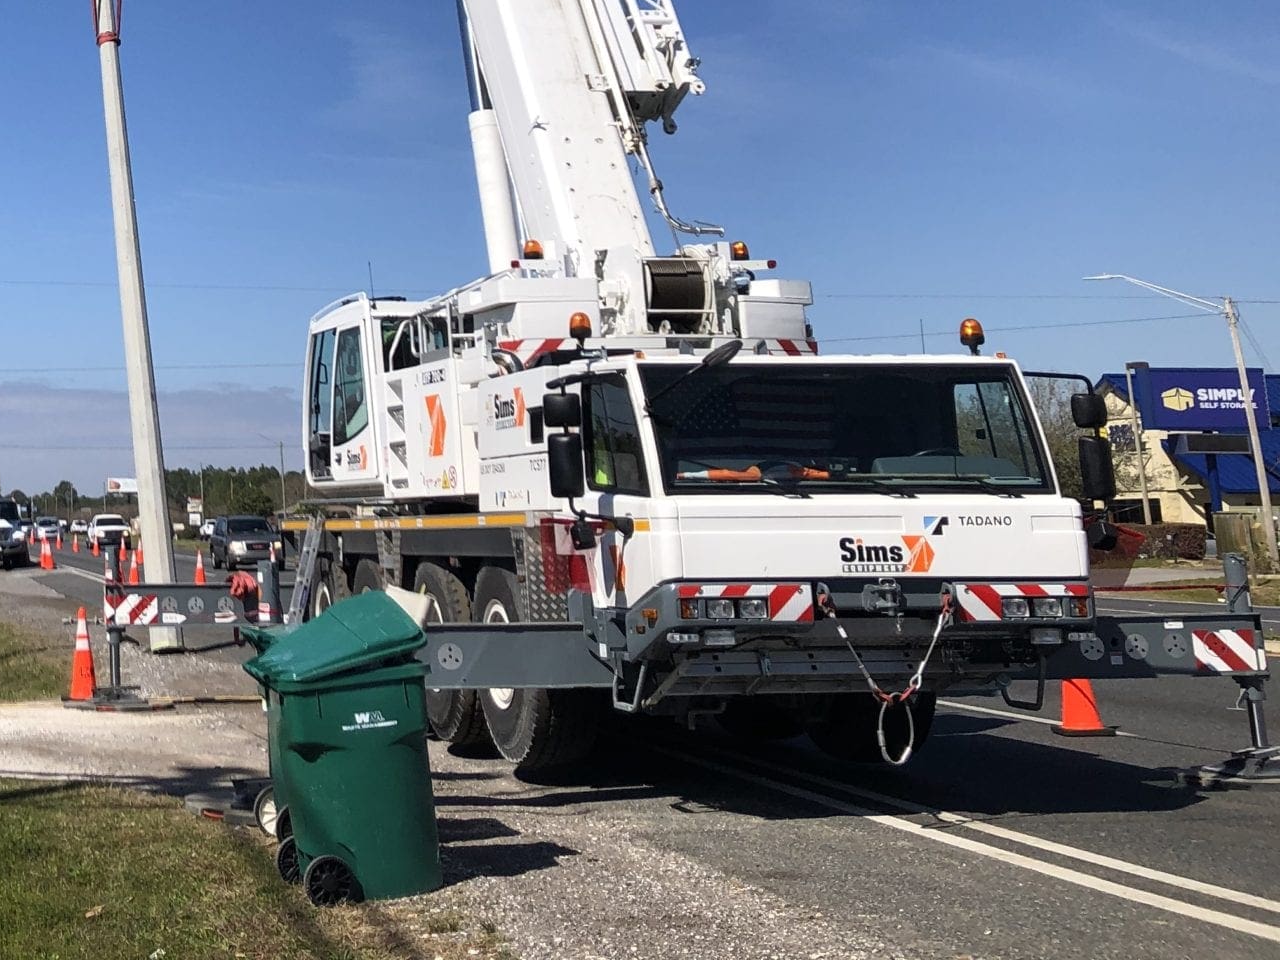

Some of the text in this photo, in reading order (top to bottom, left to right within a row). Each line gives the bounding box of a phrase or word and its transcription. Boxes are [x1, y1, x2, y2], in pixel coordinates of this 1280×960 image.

[494, 393, 515, 419] Sims
[958, 516, 1012, 526] TADANO
[839, 537, 903, 563] Sims
